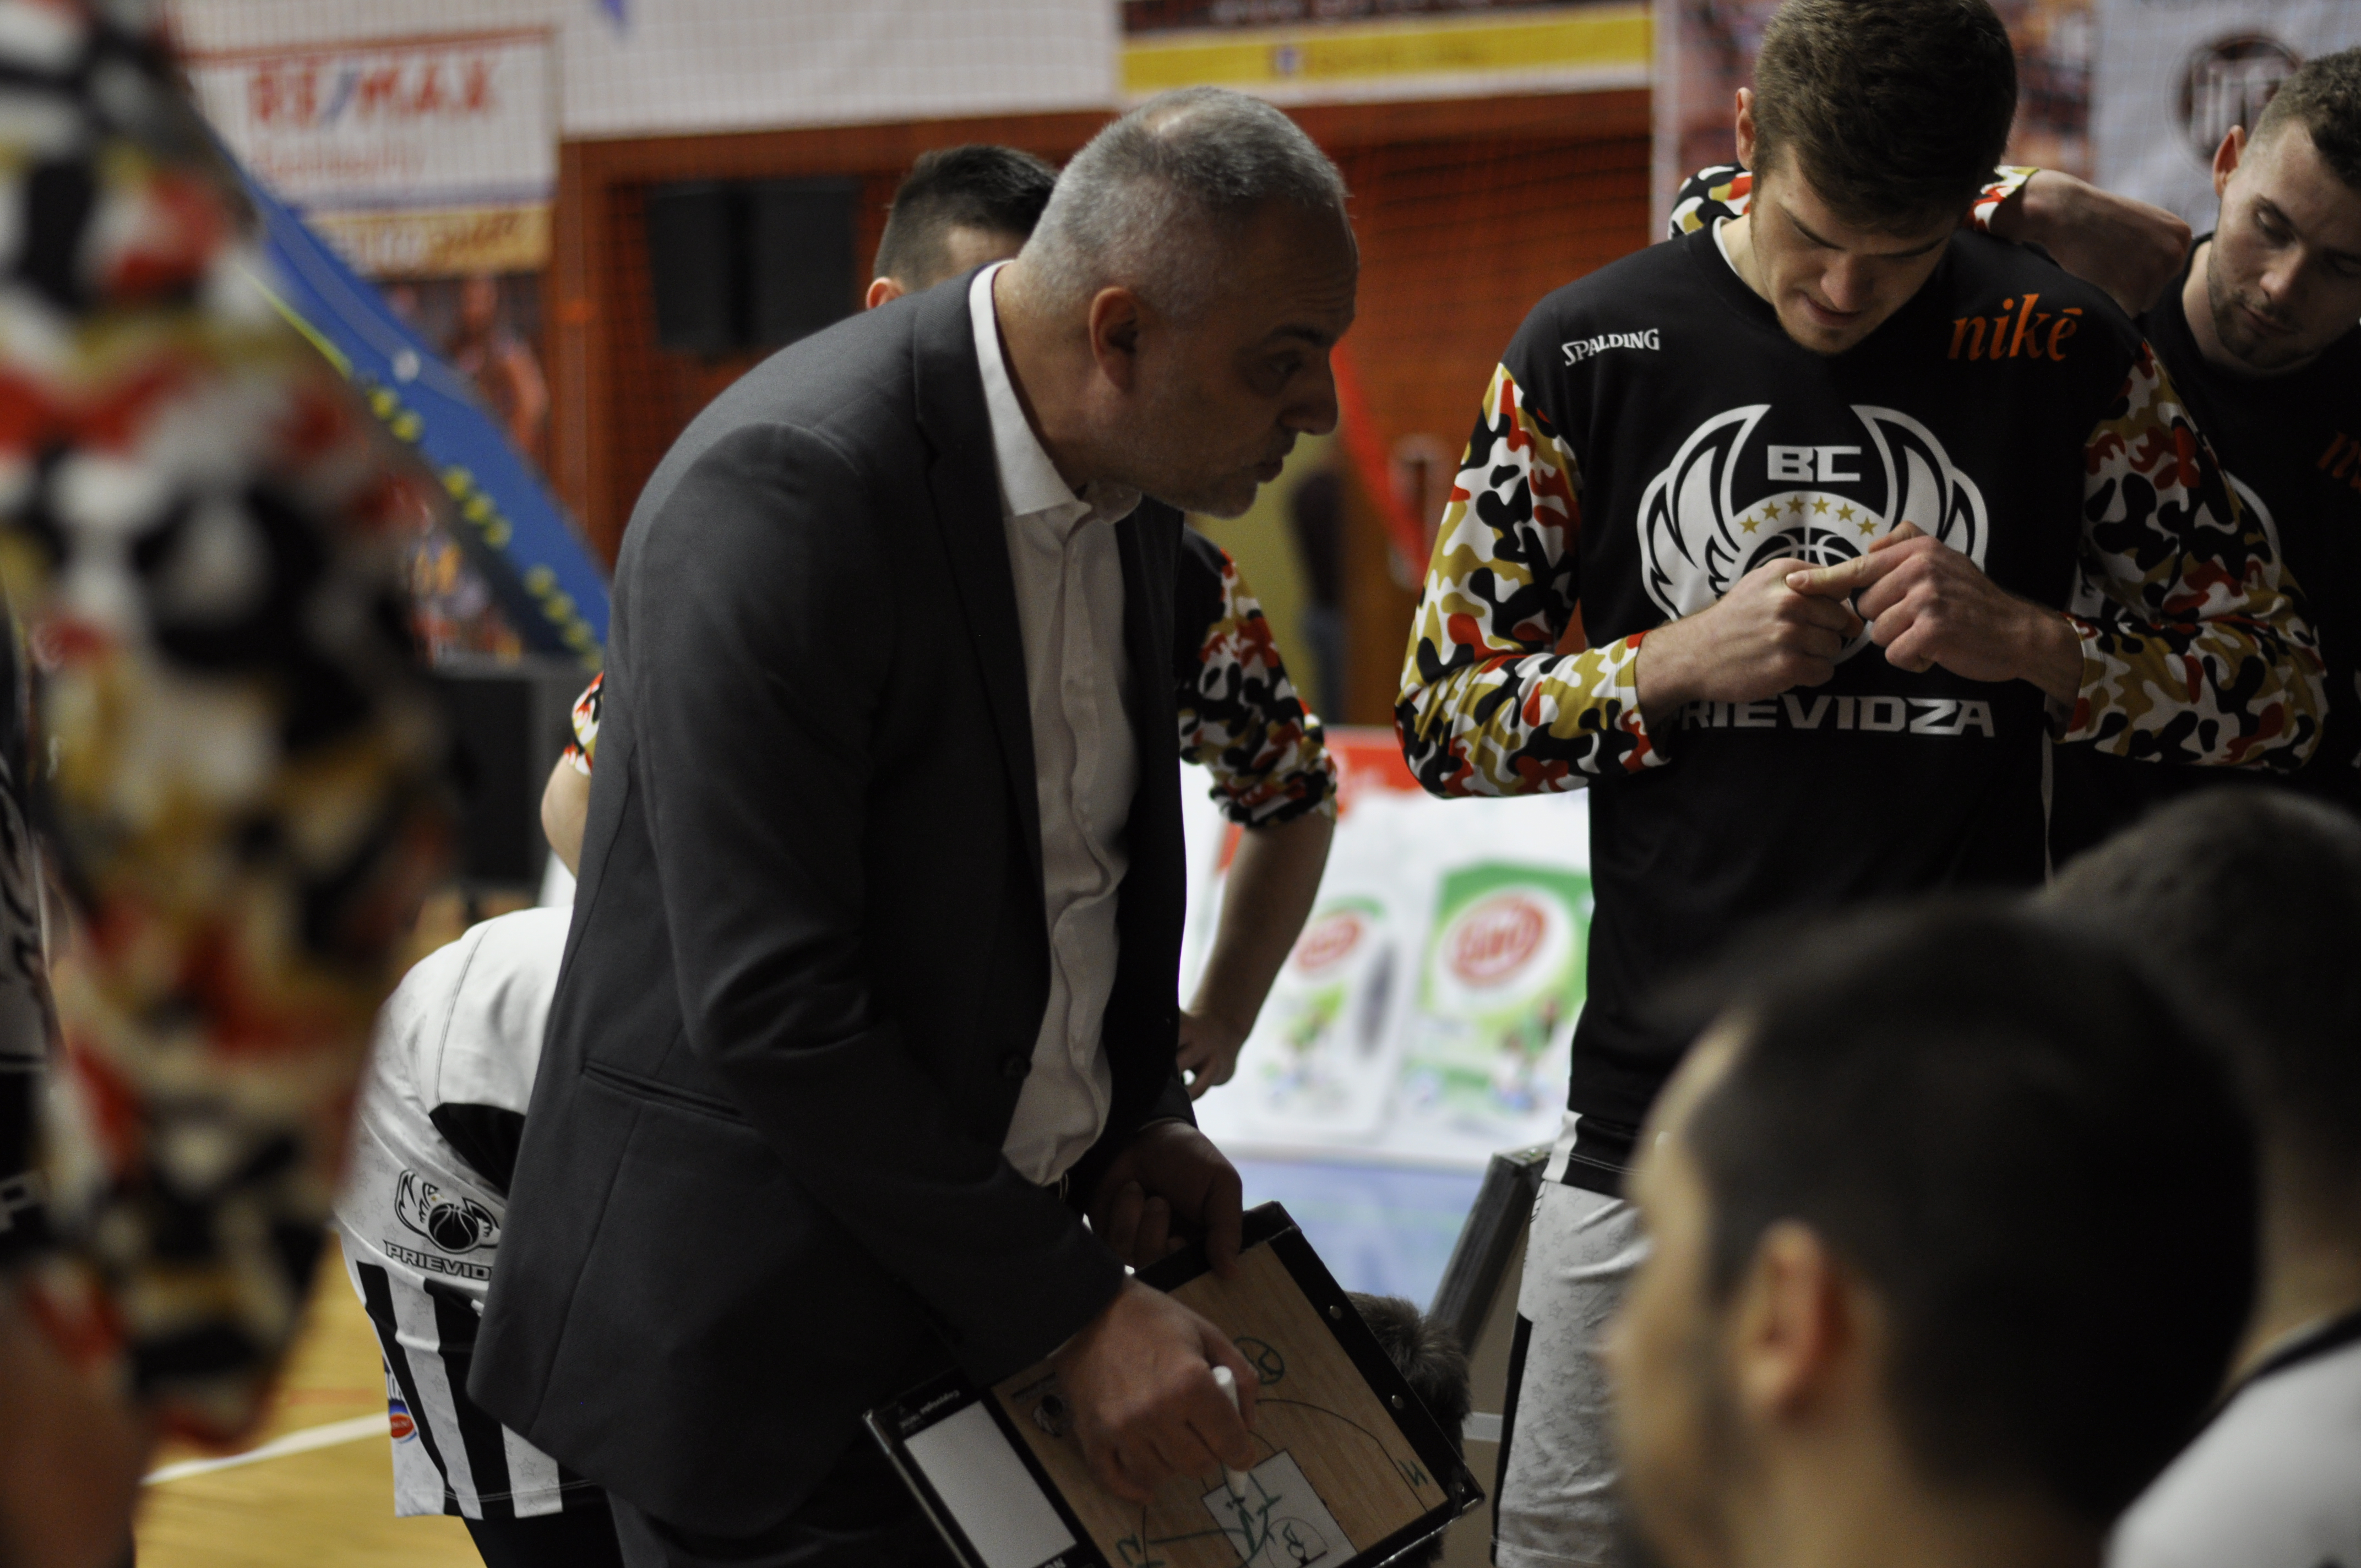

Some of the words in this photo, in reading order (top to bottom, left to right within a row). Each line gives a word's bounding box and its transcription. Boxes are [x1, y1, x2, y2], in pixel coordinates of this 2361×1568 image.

[1562, 328, 1660, 366] SPALDING
[1767, 444, 1861, 482] BC
[1674, 693, 1995, 738] RIEVIDZA
